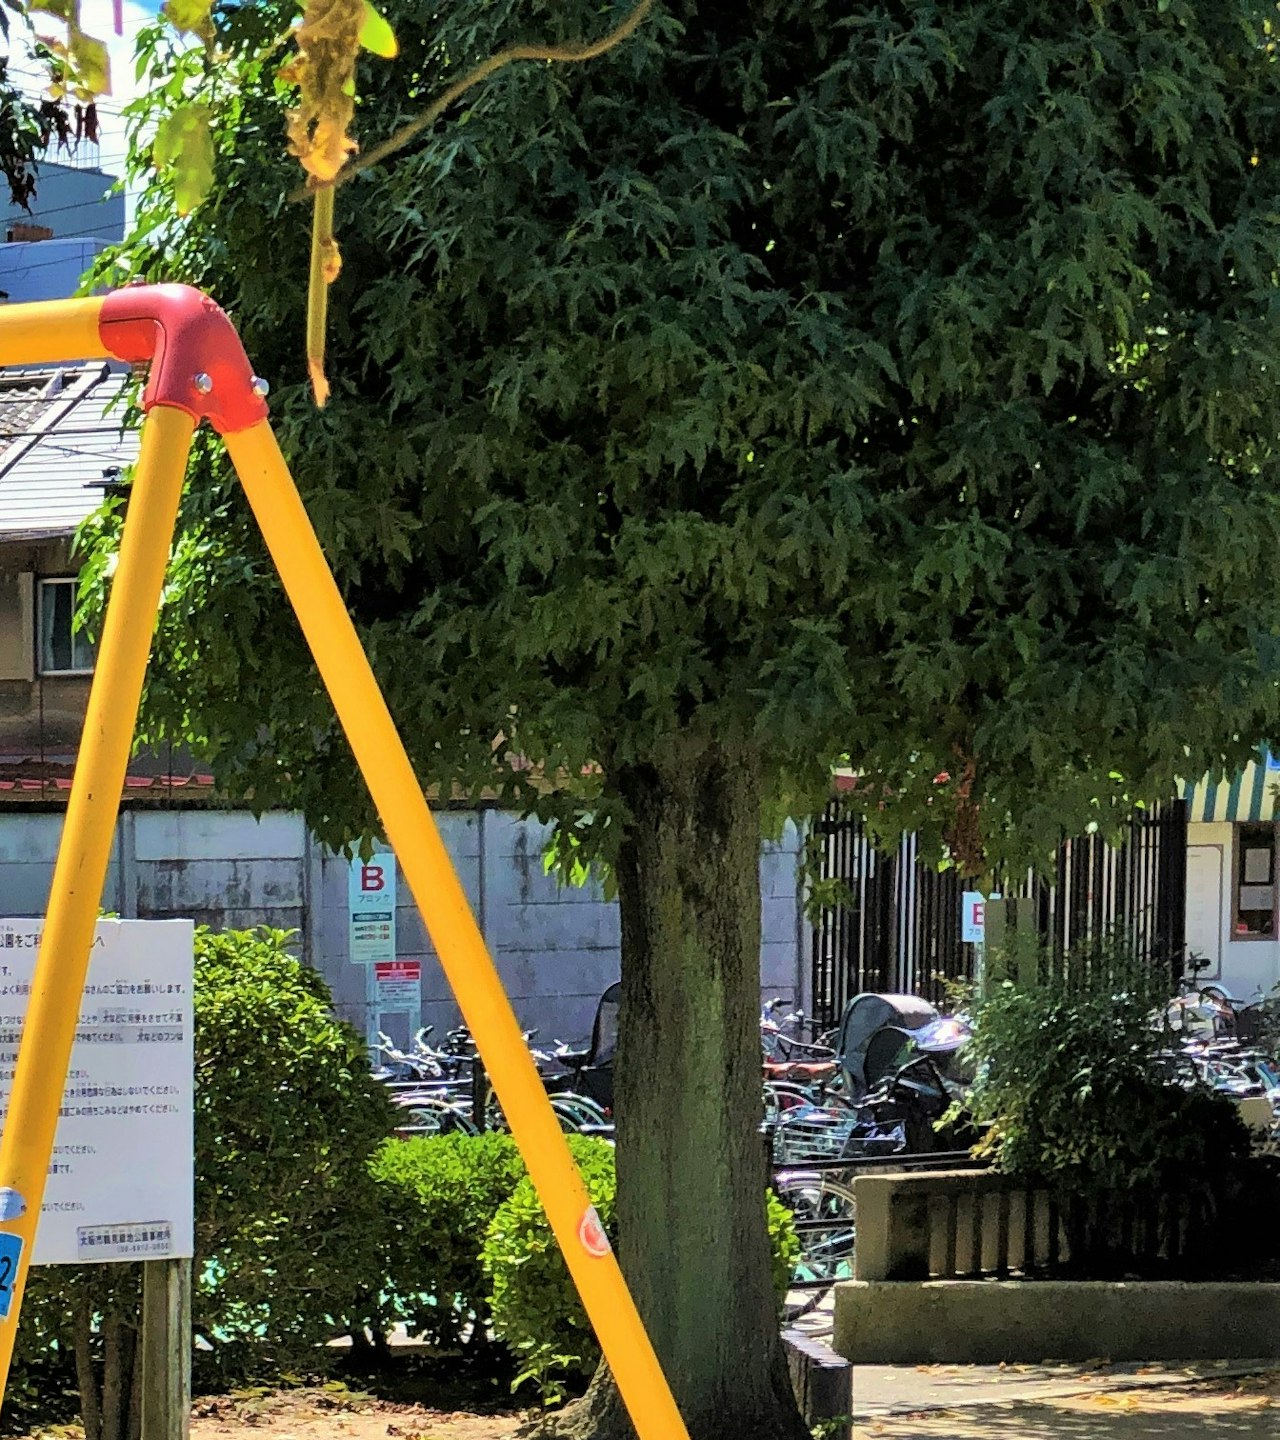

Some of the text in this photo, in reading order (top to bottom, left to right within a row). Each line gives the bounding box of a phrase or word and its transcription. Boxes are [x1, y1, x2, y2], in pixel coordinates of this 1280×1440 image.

[361, 866, 385, 891] B
[357, 894, 390, 903] ブロック
